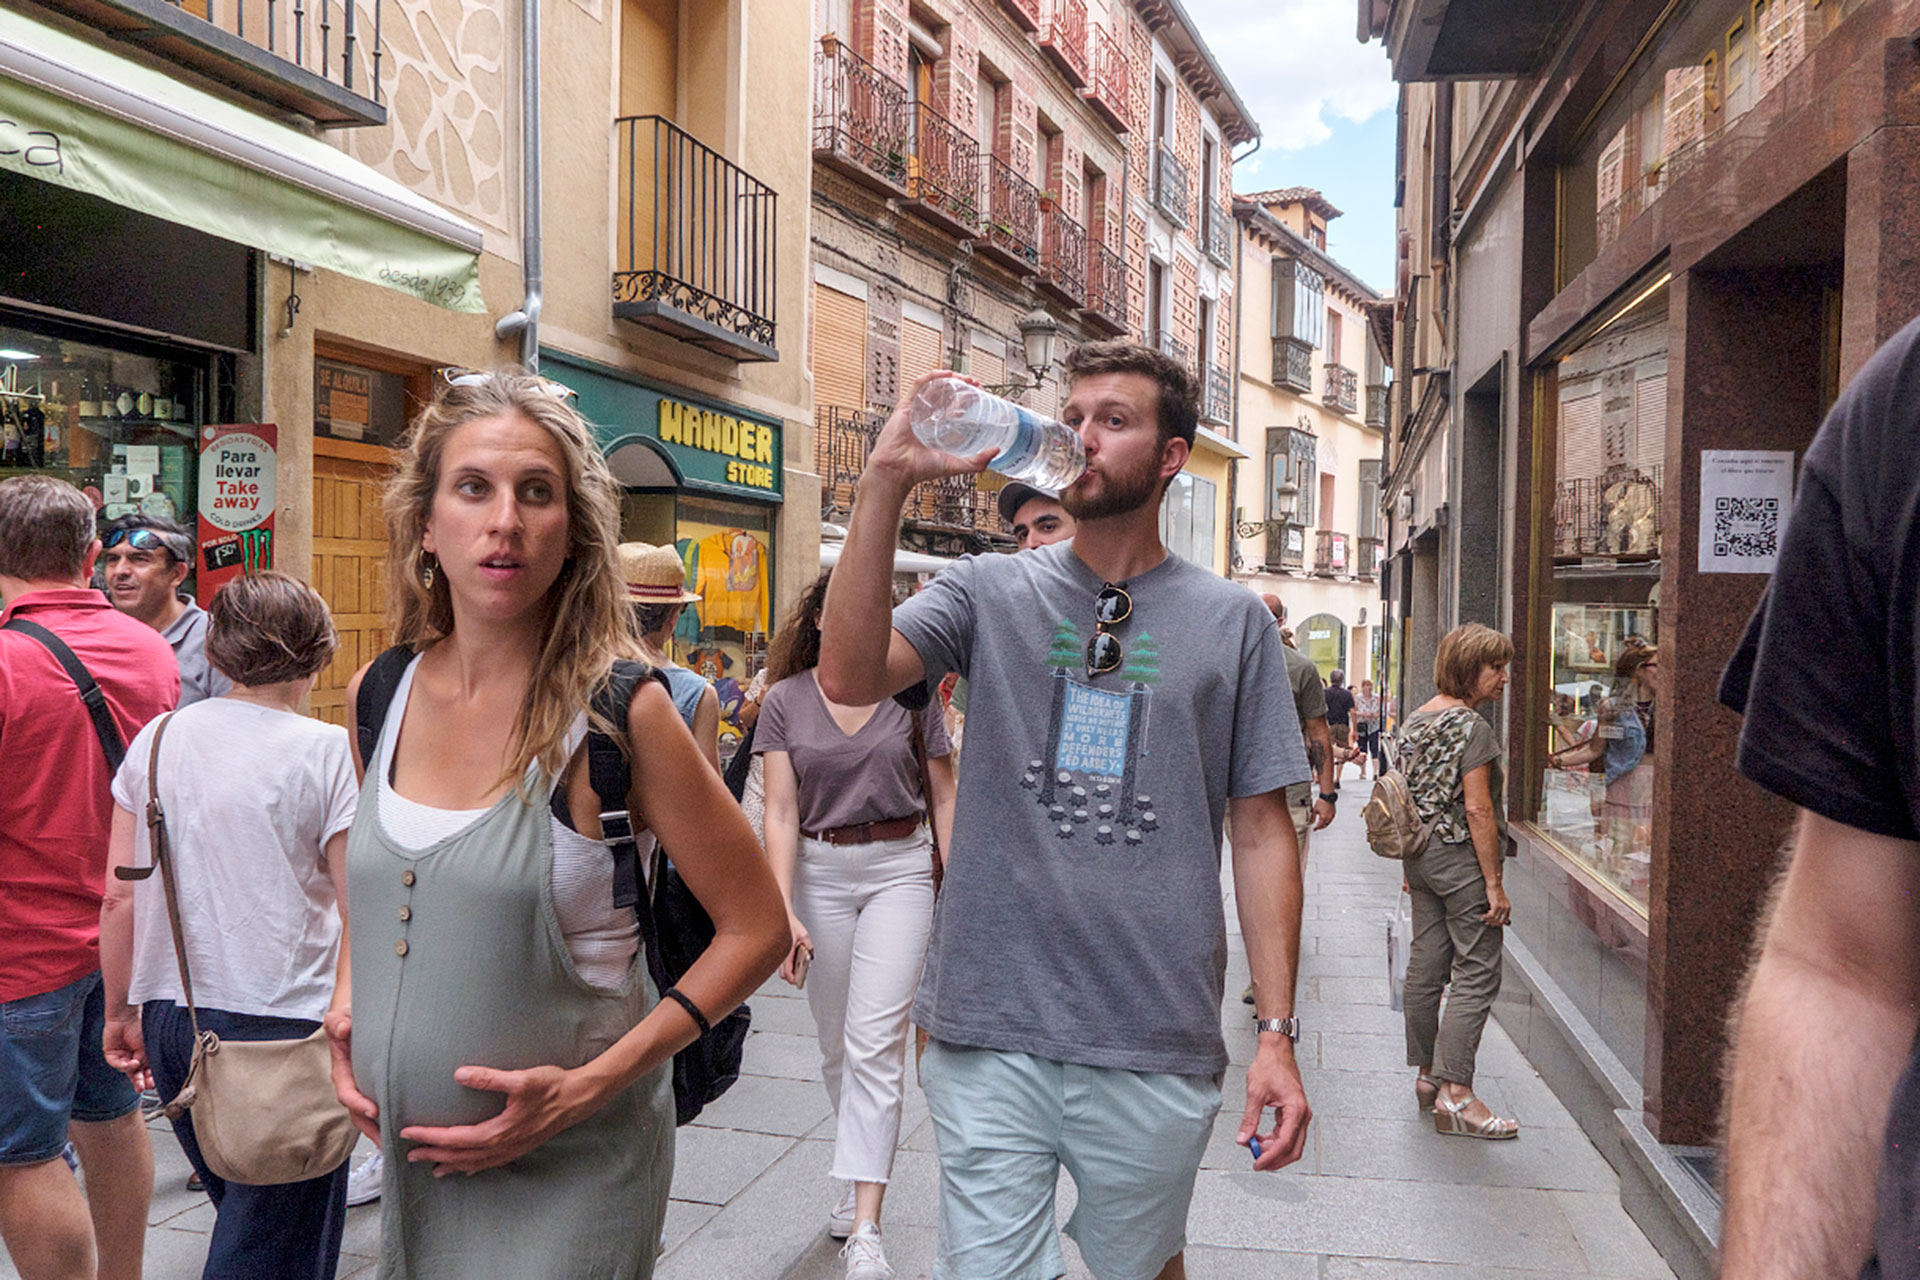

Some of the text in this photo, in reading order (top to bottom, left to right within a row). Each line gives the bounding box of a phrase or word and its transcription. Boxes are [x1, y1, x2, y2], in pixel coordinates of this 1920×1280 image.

[379, 260, 428, 292] desde
[320, 368, 331, 387] SE
[659, 398, 772, 465] WANDER
[221, 450, 256, 463] Para
[216, 464, 261, 478] llevar
[727, 461, 773, 489] STORE
[216, 480, 259, 495] Take
[213, 497, 260, 511] away
[210, 512, 263, 528] COLD DRINKS
[1070, 687, 1089, 704] THE
[1113, 700, 1125, 711] OF
[1068, 703, 1126, 720] WILDERNESS
[1061, 742, 1122, 758] DEFENDERS
[1065, 754, 1080, 767] ED
